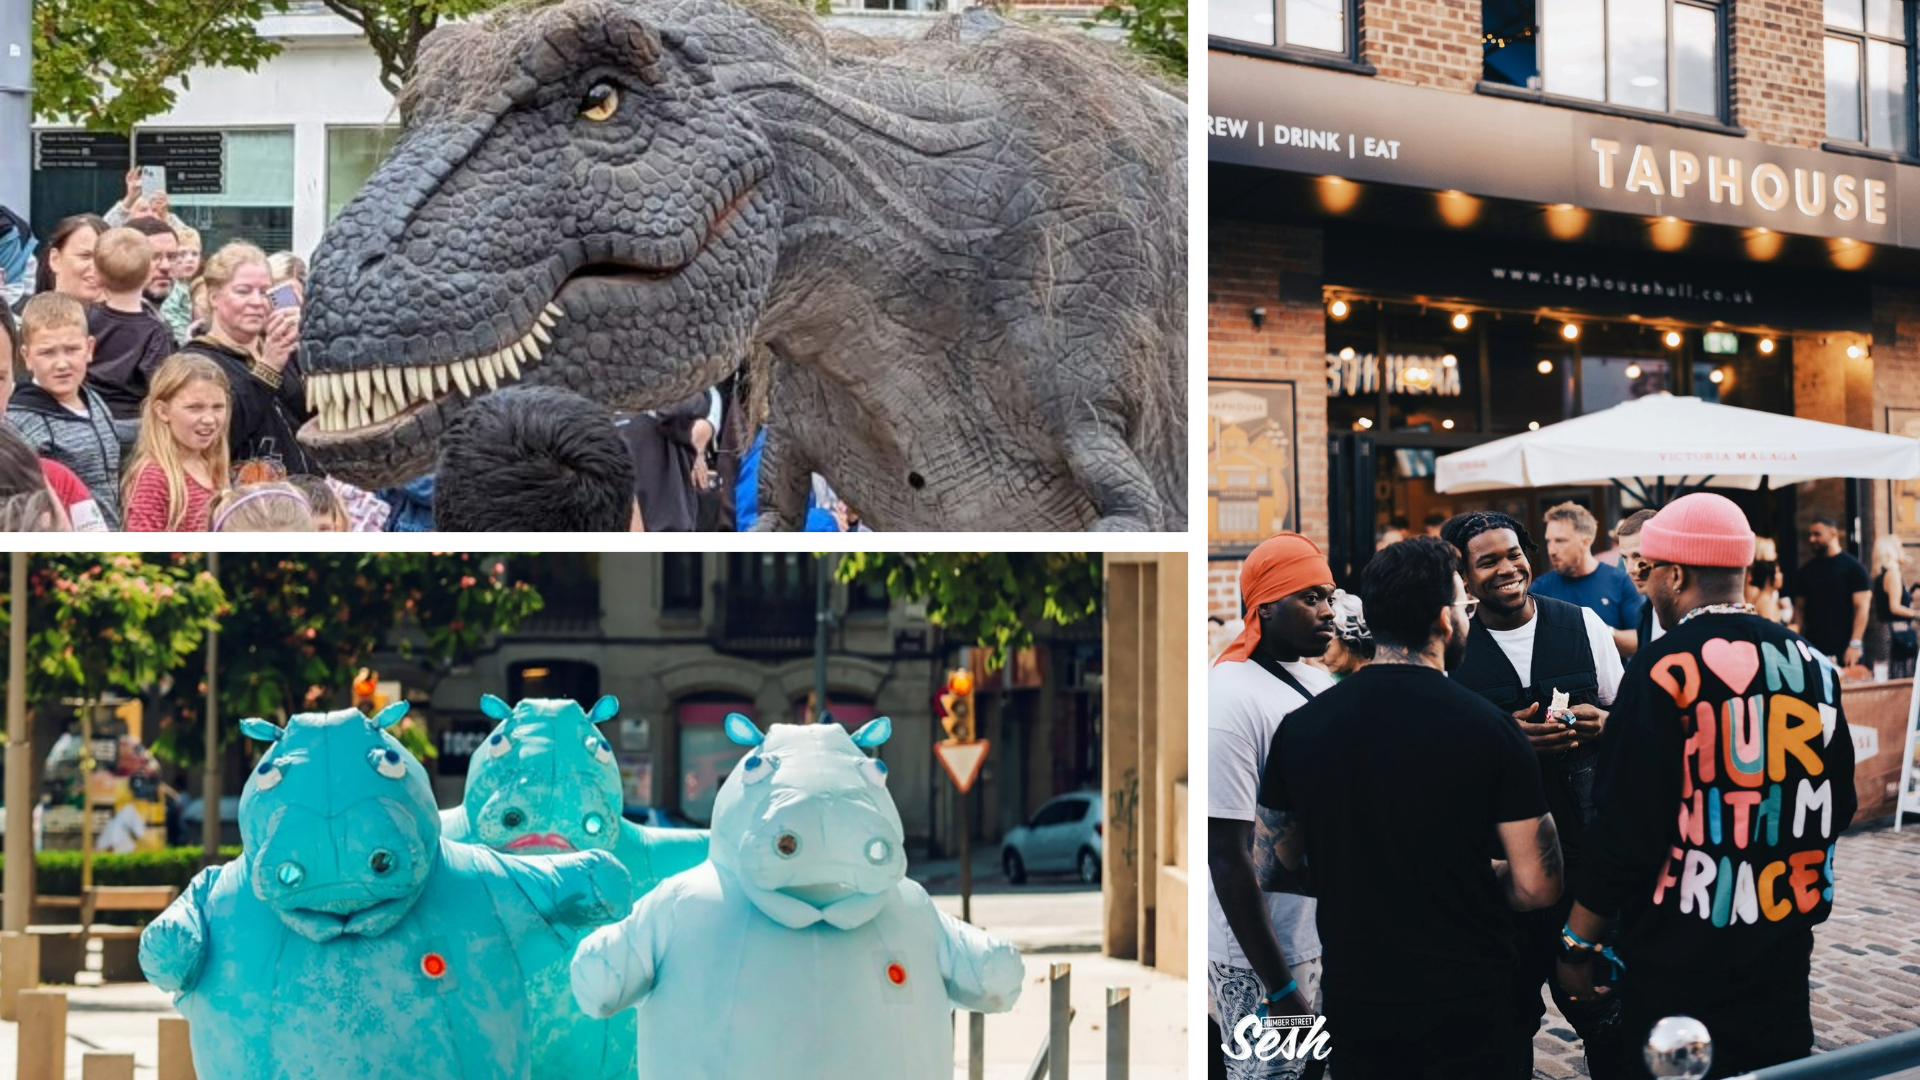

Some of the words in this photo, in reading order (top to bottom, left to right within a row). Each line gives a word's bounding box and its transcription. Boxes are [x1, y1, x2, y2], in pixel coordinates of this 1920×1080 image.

[1274, 124, 1341, 152] DRINK
[1364, 137, 1401, 160] EAT
[1591, 137, 1887, 225] TAPHOUSE
[1491, 267, 1754, 304] www.taphousehull.co.uk
[1658, 452, 1730, 462] VICTORIA
[1678, 783, 1782, 849] WITH
